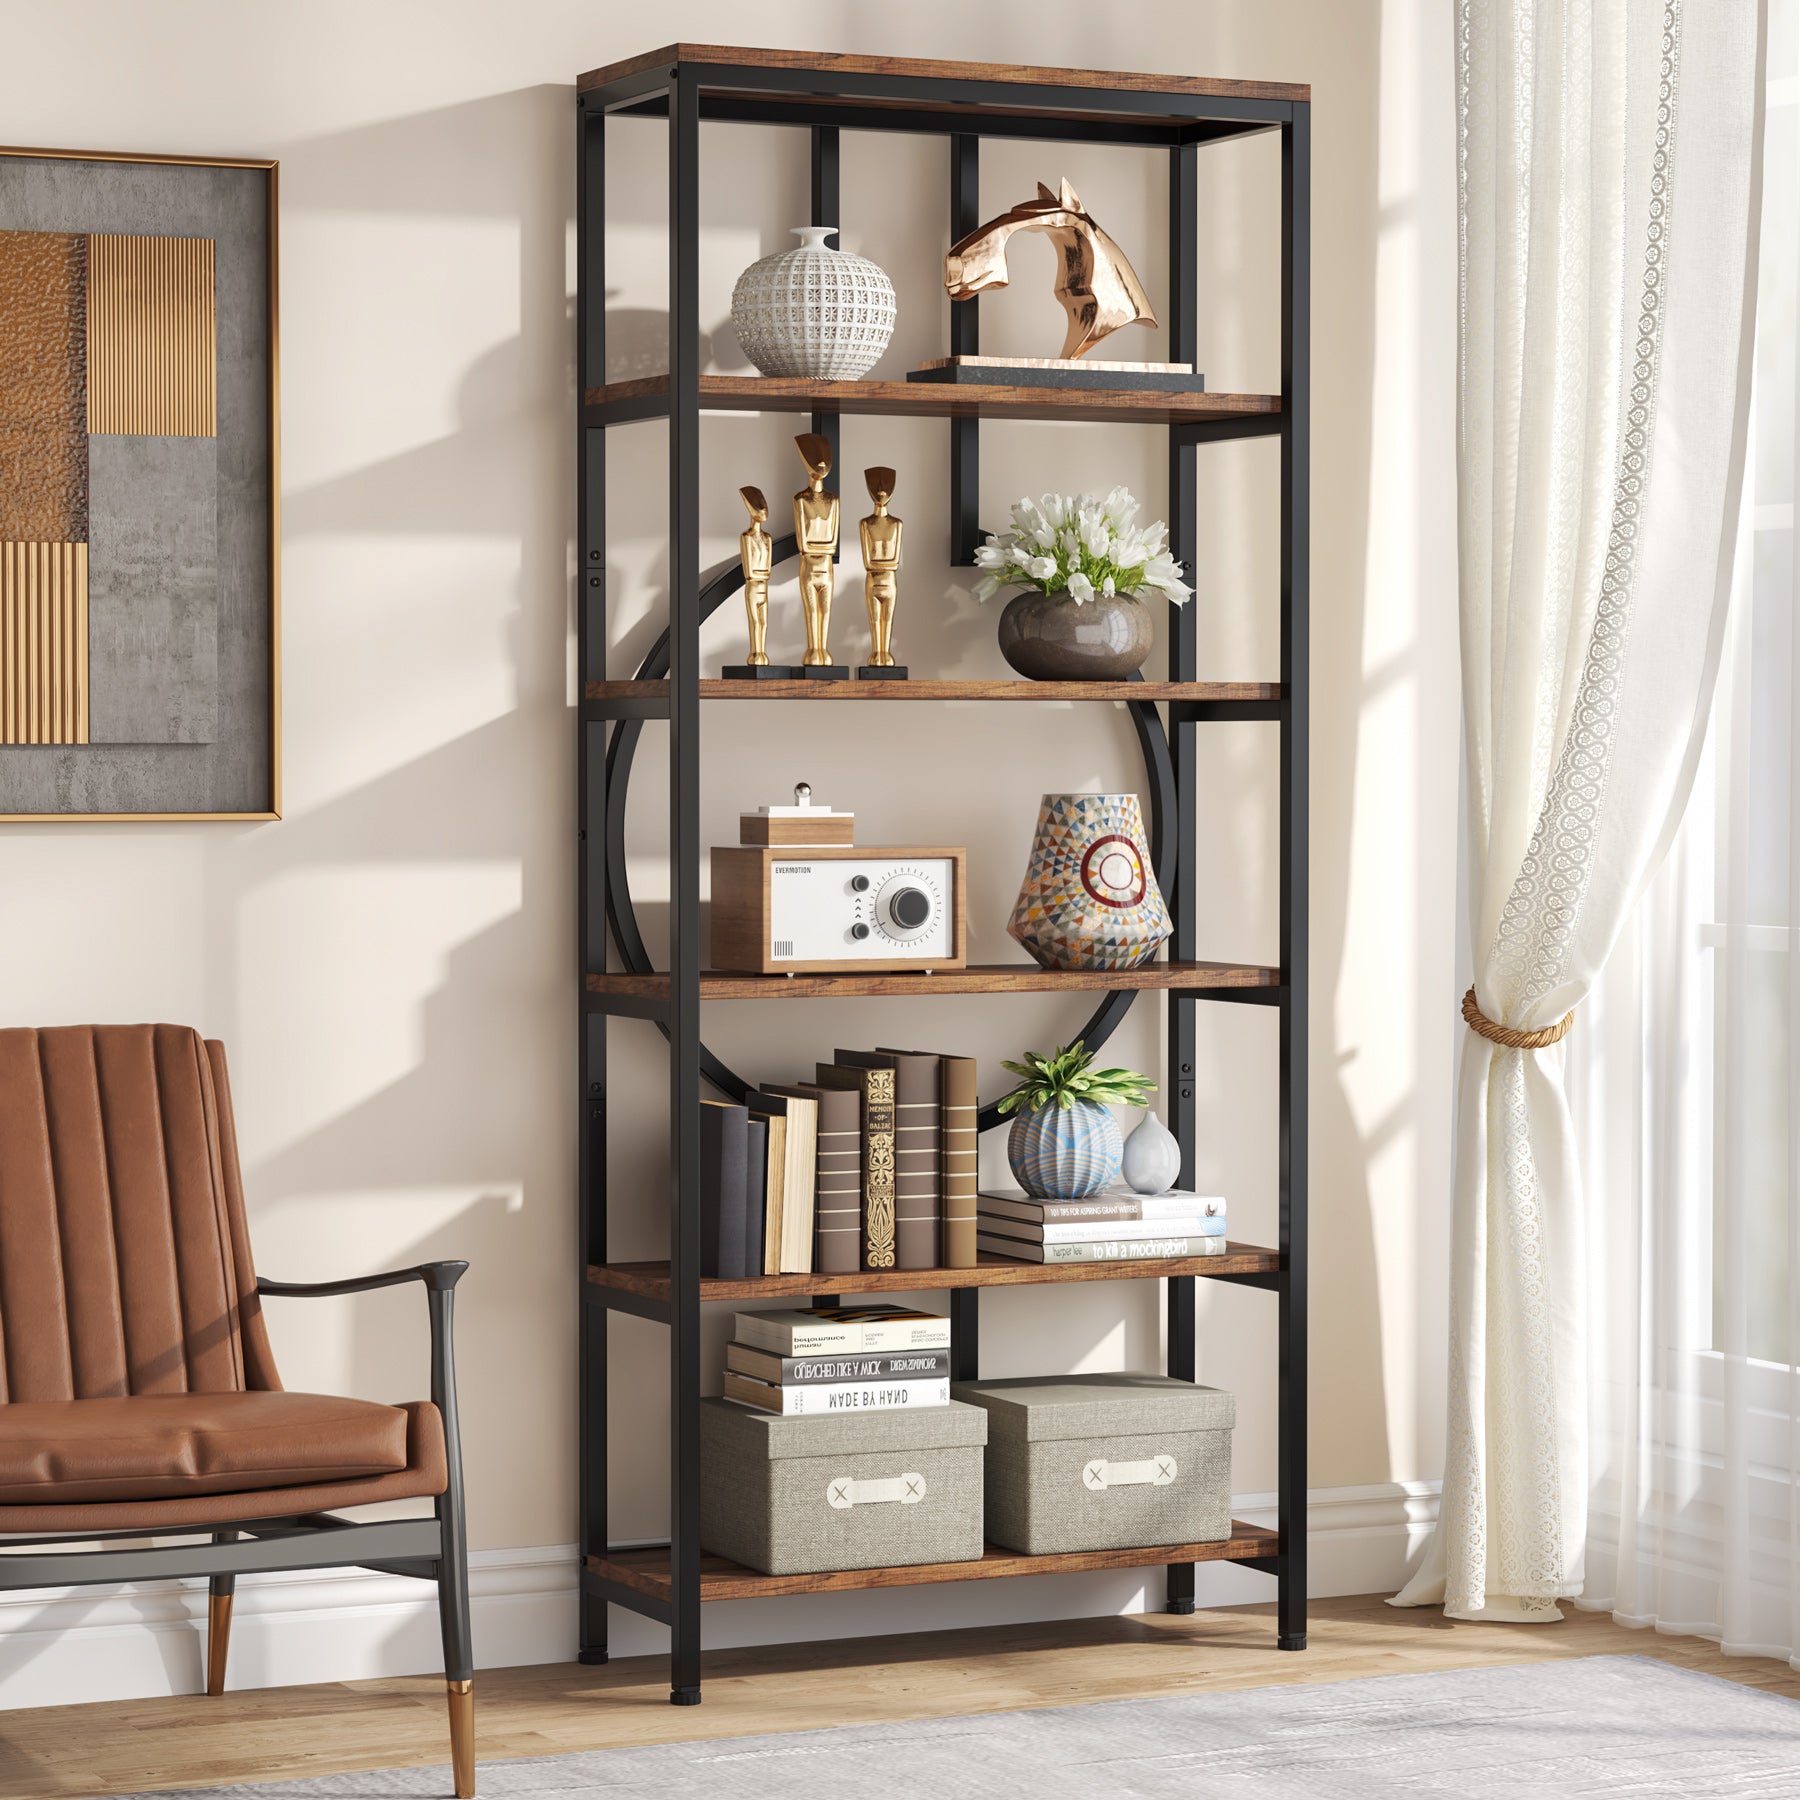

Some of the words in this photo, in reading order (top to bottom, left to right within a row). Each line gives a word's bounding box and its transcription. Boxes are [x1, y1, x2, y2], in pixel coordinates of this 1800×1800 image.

[775, 866, 812, 874] EVERMOTION
[1050, 1207, 1060, 1217] 101
[1060, 1207, 1070, 1216] TIPS
[1070, 1207, 1080, 1216] FOR
[1080, 1206, 1101, 1216] ASPIRING
[1101, 1206, 1119, 1215] GRANT
[1119, 1205, 1138, 1214] WRITERS
[1053, 1246, 1072, 1258] harper
[1072, 1244, 1083, 1256] lee
[1092, 1244, 1104, 1259] to
[1105, 1241, 1118, 1257] kill
[1120, 1244, 1127, 1257] a
[1129, 1238, 1188, 1258] mockingbird
